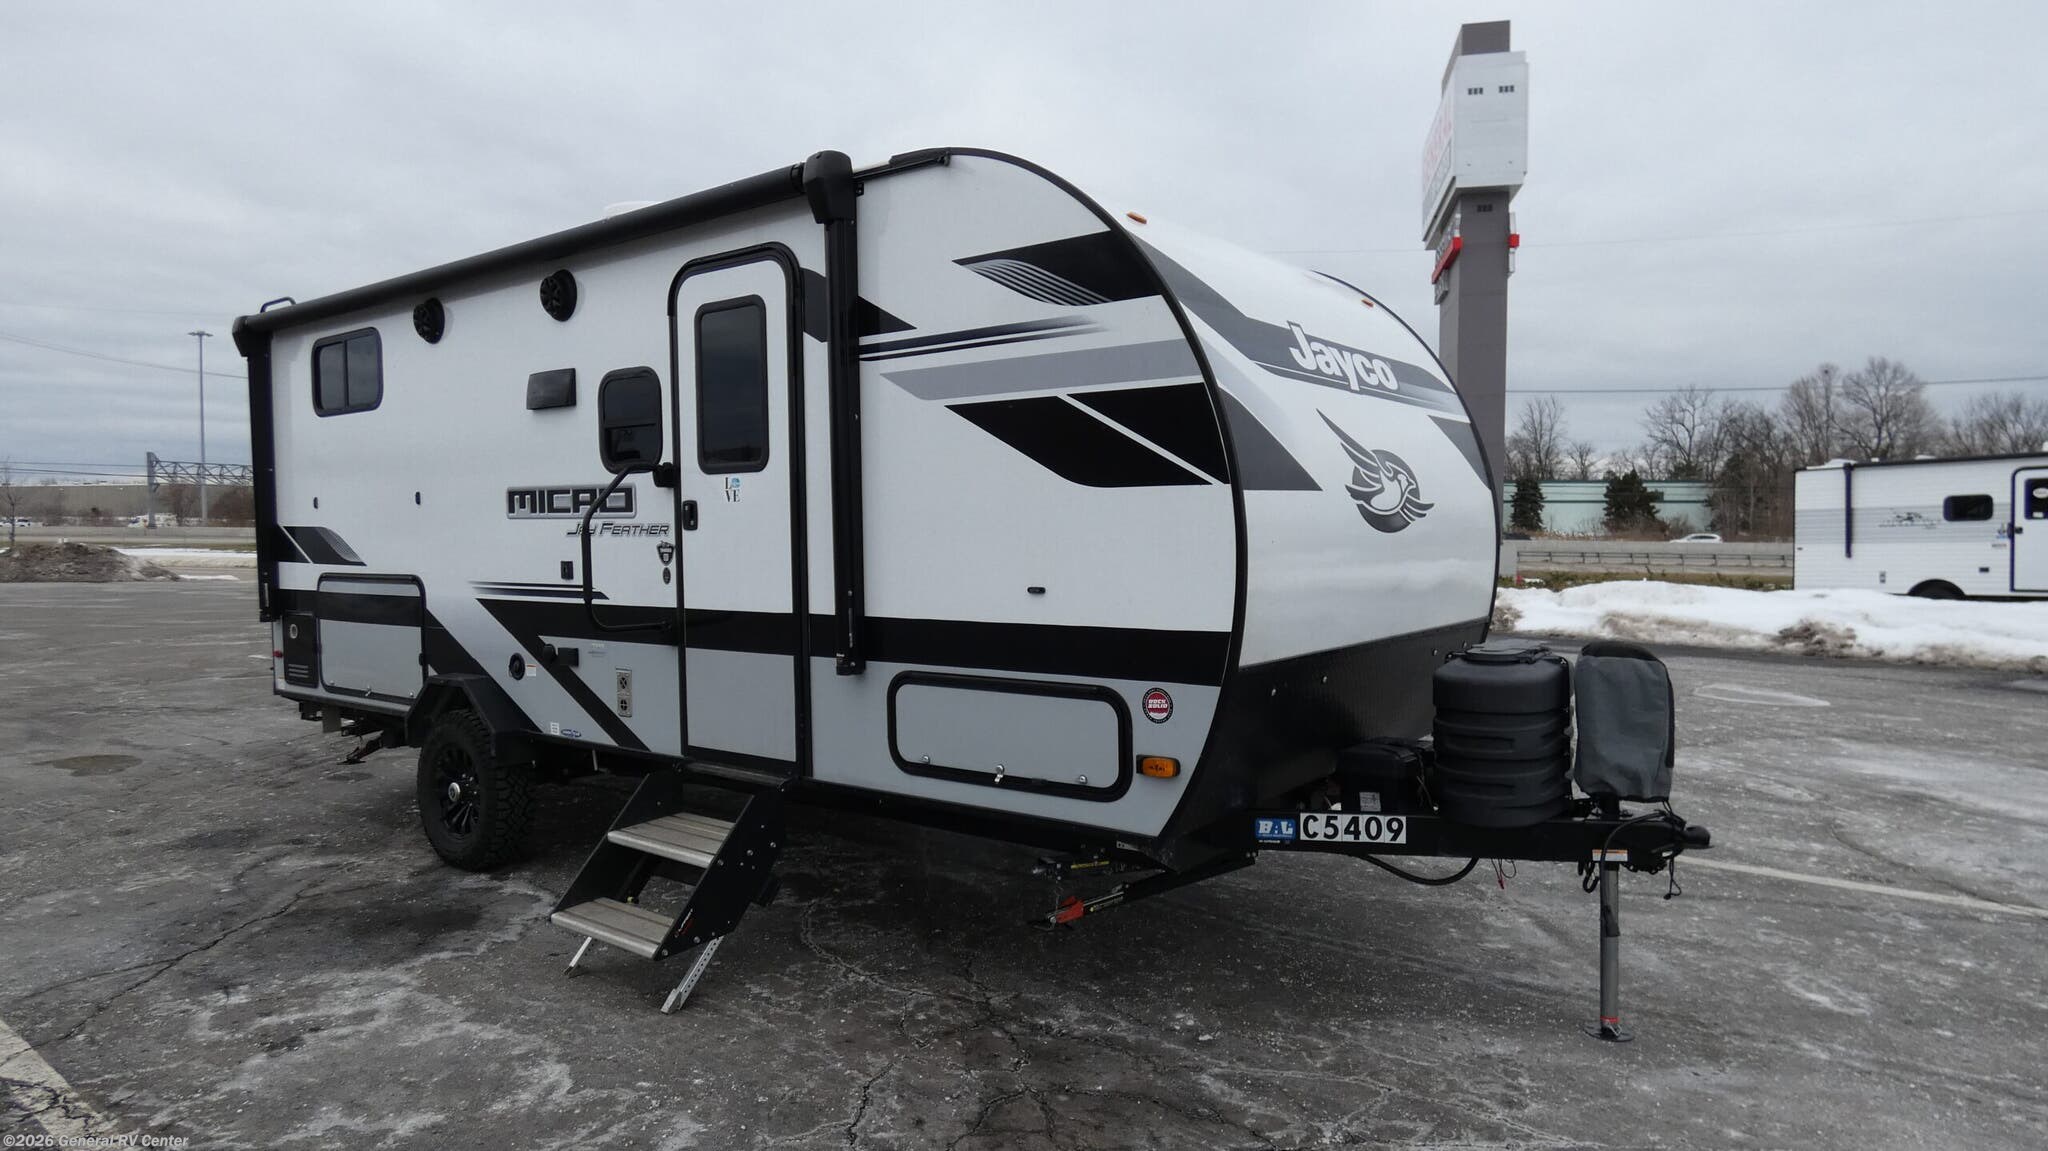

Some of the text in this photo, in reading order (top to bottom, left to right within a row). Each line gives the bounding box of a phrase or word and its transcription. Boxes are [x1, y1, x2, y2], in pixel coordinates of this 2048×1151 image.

[1287, 321, 1399, 393] Jayco
[507, 486, 634, 515] MICRO
[600, 522, 670, 536] FEATHER
[1302, 814, 1404, 842] C5409
